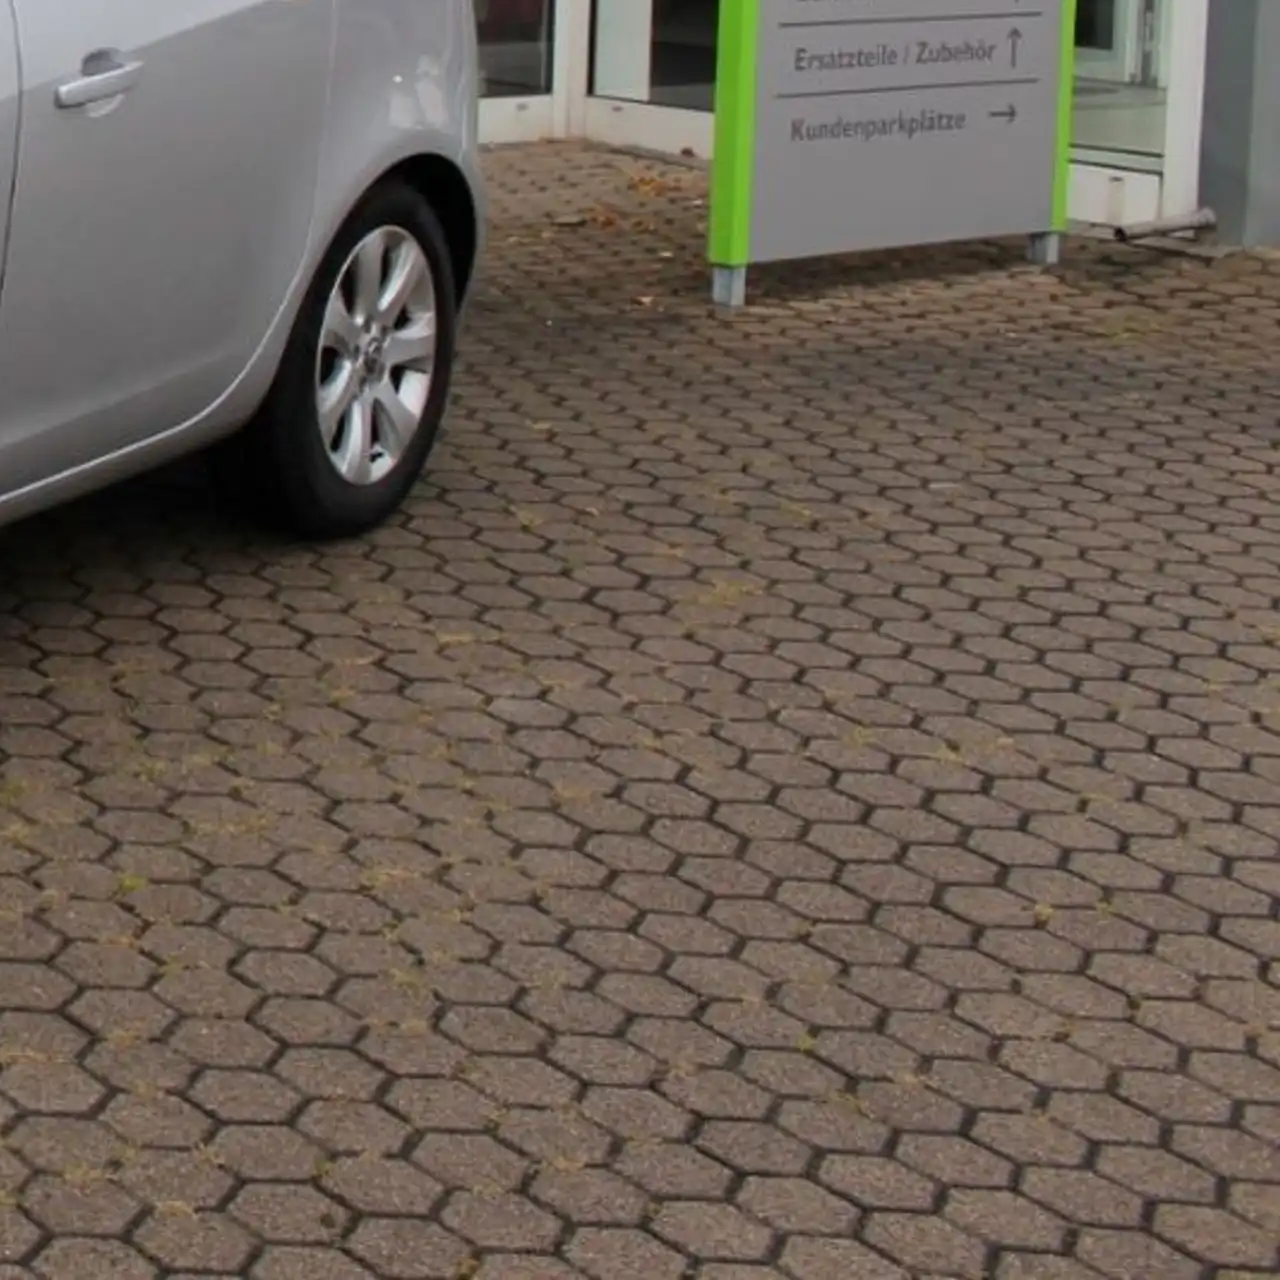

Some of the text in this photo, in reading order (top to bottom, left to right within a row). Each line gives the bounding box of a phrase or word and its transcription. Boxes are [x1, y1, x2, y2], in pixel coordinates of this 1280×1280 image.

[794, 44, 898, 71] Ersatzteile
[915, 38, 996, 64] Zubehör
[790, 108, 967, 142] Kundenparkplätze
